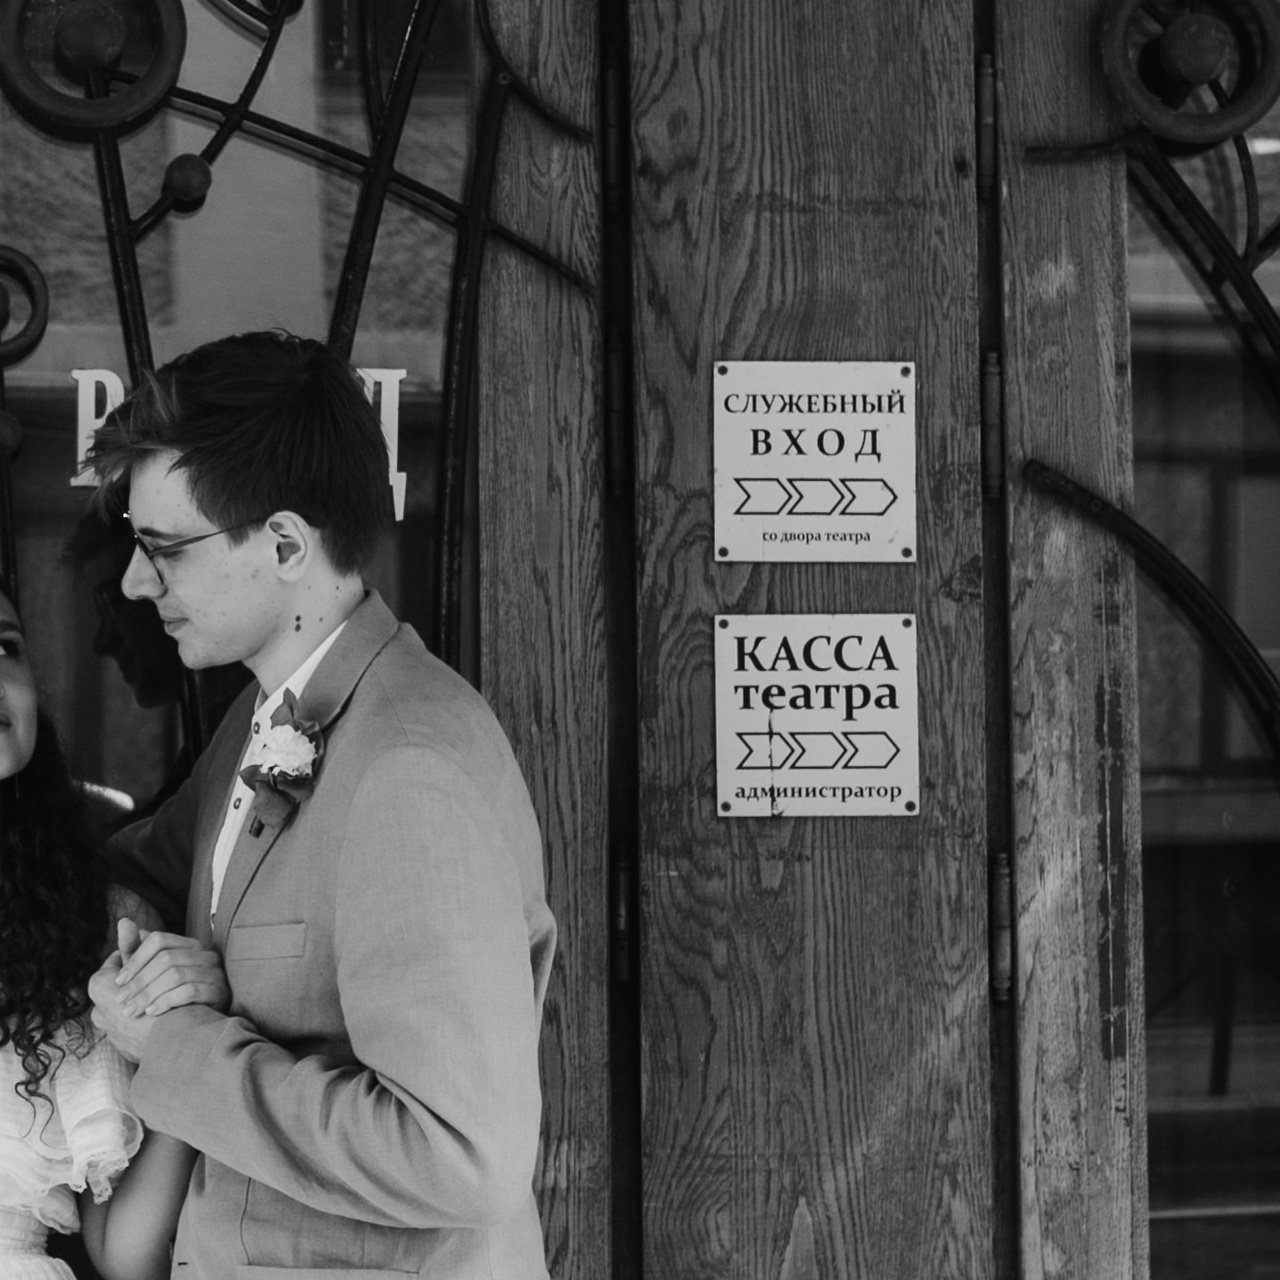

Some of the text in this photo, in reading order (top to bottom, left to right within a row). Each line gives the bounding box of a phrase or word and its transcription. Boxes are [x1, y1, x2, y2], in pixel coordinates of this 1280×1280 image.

[723, 389, 907, 415] СЛУЖЕБНЫЙ
[750, 428, 883, 464] ВХОД
[762, 531, 871, 545] со двора театра
[733, 635, 900, 672] КАССА
[733, 683, 900, 721] театра
[734, 785, 902, 803] администратор
